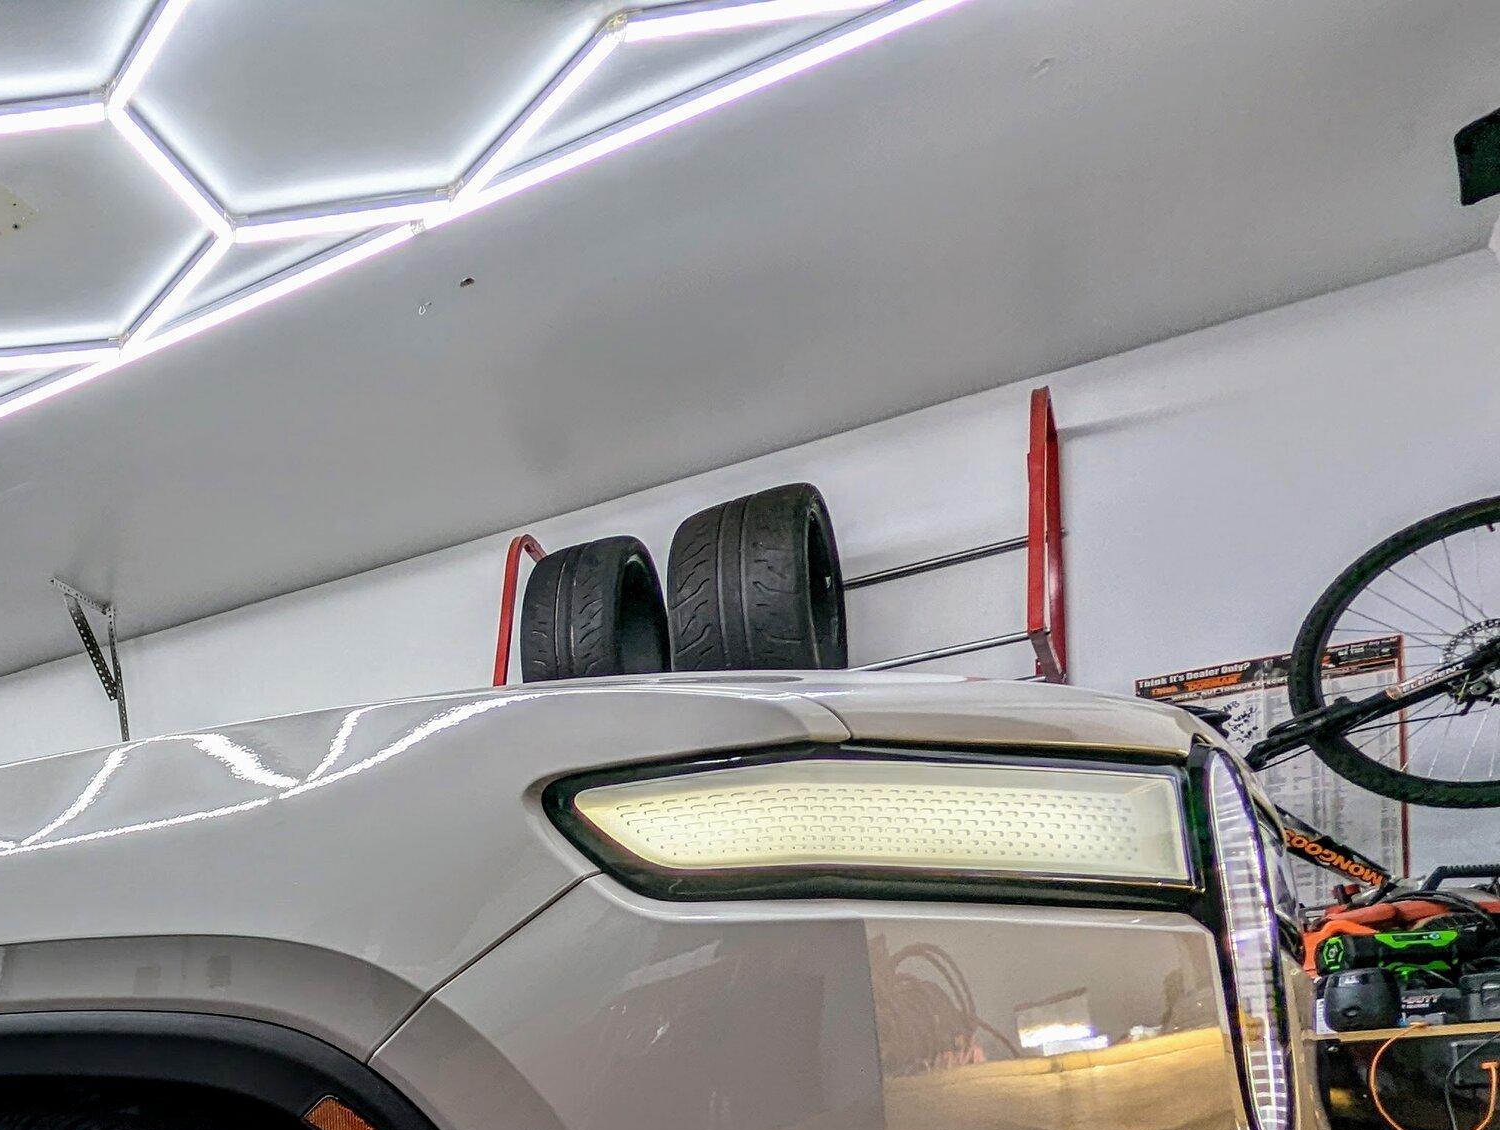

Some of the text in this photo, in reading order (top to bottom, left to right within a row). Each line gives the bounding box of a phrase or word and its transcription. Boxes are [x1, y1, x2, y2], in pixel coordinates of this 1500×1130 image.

[1186, 668, 1219, 681] Dealer
[1221, 662, 1250, 675] Only?
[1403, 662, 1466, 693] ELEMENT
[1284, 828, 1386, 887] MONGOOS
